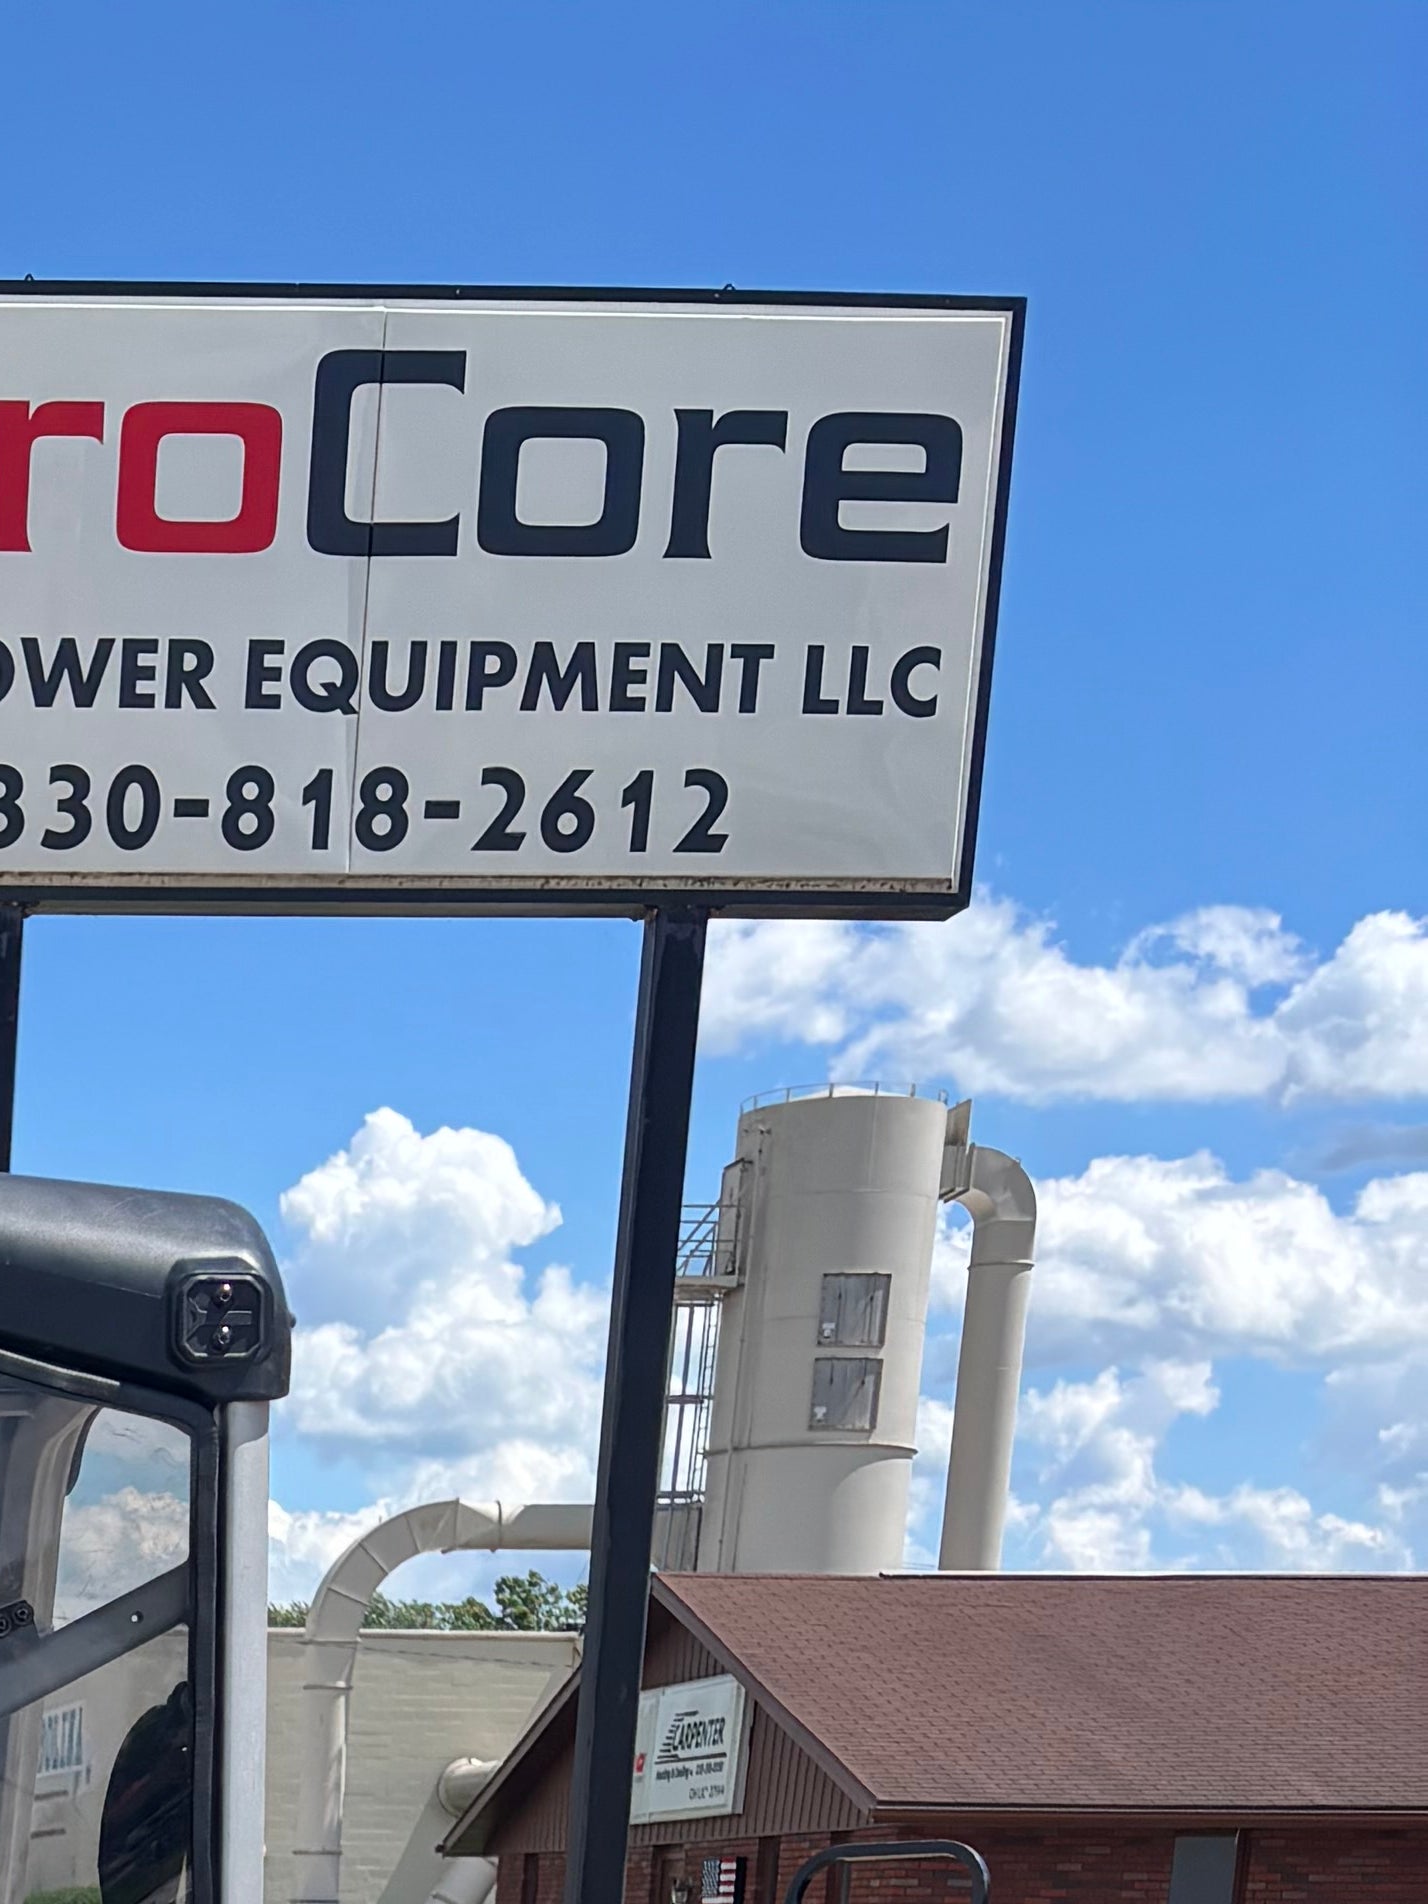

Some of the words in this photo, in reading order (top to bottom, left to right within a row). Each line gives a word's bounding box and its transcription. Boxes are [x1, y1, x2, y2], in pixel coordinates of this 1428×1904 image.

[245, 637, 775, 716] EQUIPMENT
[800, 643, 942, 718] LLC
[670, 1716, 726, 1752] CARPENTER
